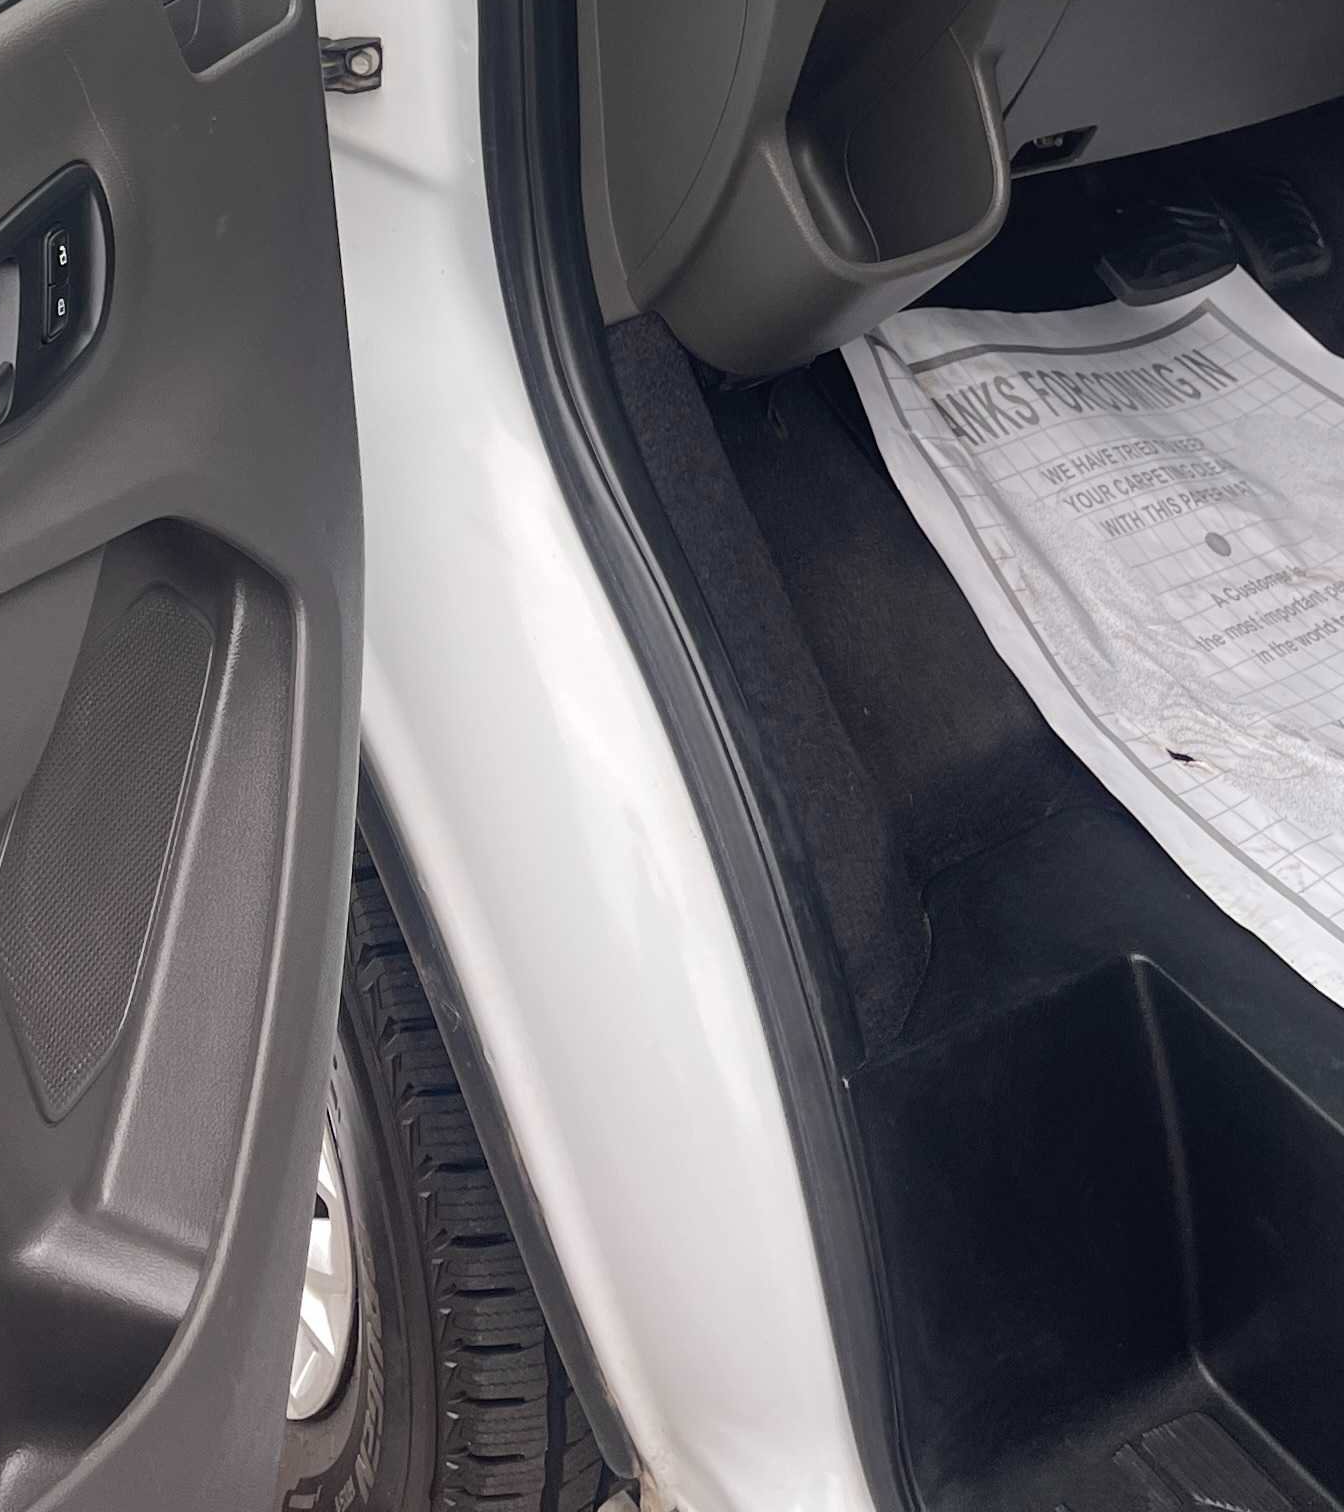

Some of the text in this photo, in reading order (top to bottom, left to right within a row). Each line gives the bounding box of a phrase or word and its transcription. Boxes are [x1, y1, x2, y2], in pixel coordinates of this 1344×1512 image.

[1174, 348, 1238, 391] IN
[1040, 463, 1076, 486] WE
[1071, 449, 1118, 476] HAVE
[1112, 439, 1159, 463] TRIED
[1063, 484, 1116, 513] YOUR
[1100, 509, 1146, 537] WITH
[1141, 496, 1183, 524] THIS
[1196, 629, 1227, 653] the
[1224, 615, 1265, 641] most
[1254, 589, 1329, 625] important
[1209, 592, 1230, 608] A
[1250, 648, 1274, 665] in
[1270, 636, 1299, 659] the
[1295, 617, 1338, 648] world
